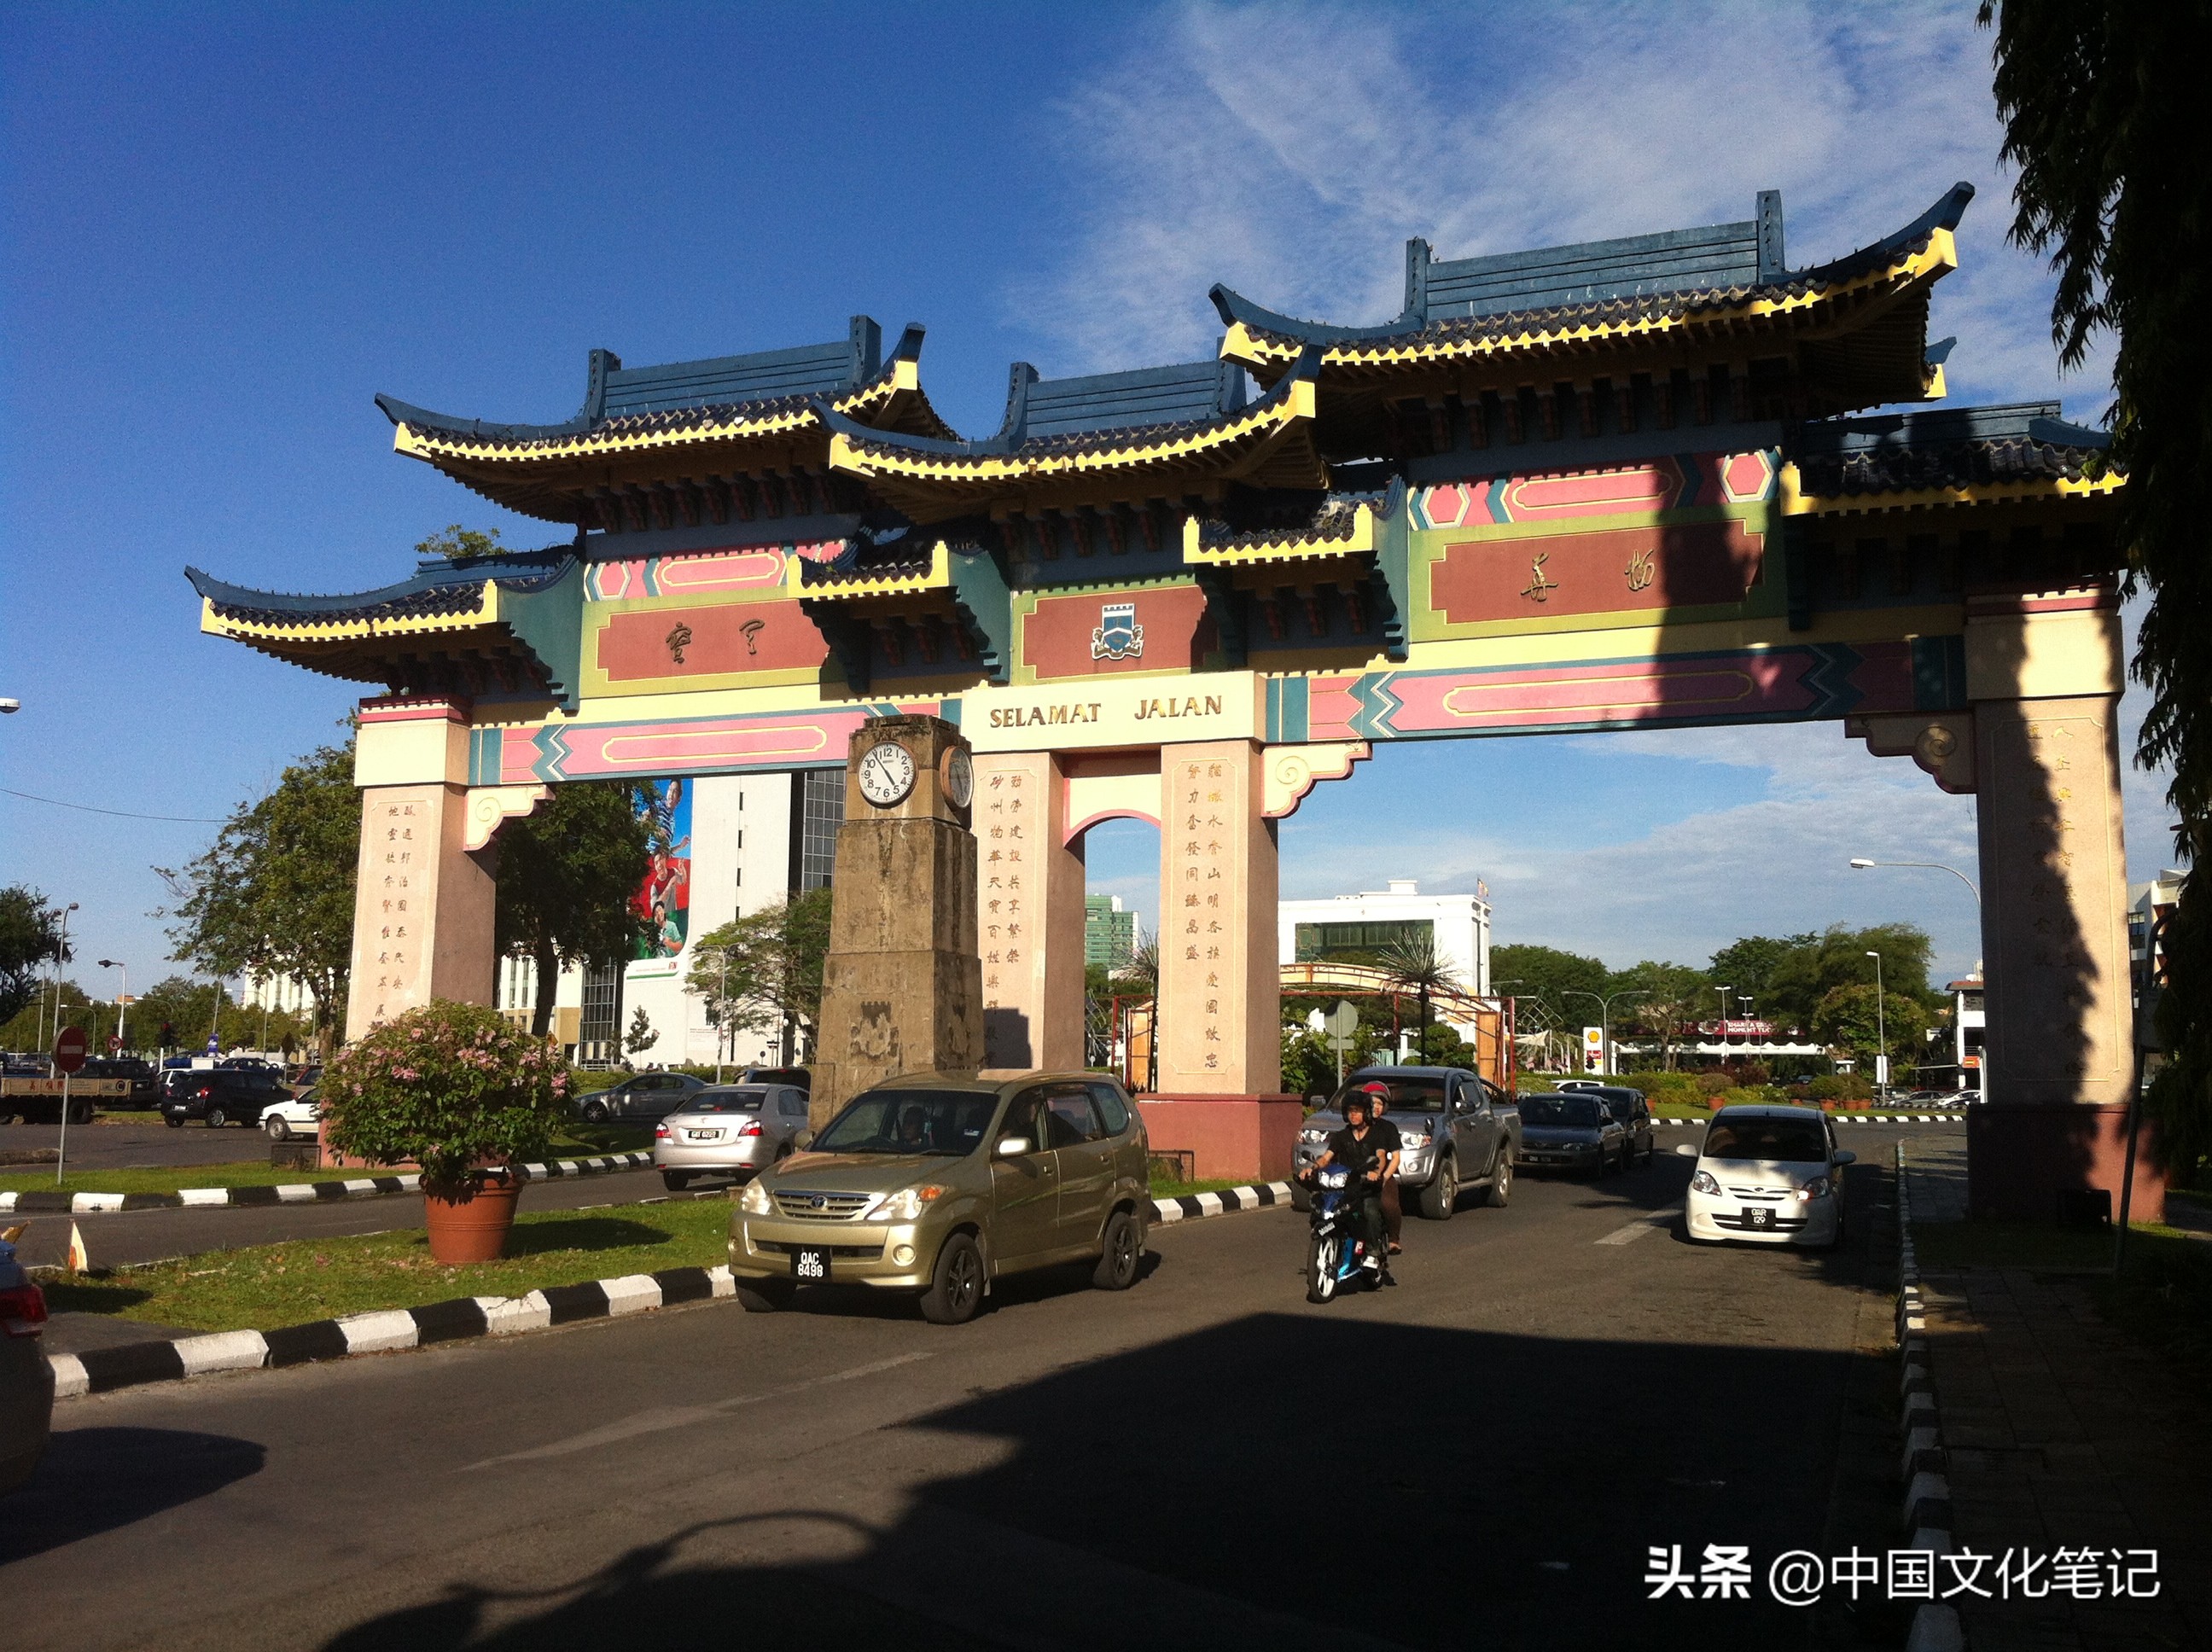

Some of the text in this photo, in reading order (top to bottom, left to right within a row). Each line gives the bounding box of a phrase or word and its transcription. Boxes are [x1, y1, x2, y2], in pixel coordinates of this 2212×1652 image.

[990, 695, 1222, 728] SELAMAT JALAN
[800, 1252, 819, 1265] QAC
[797, 1263, 824, 1277] 8498
